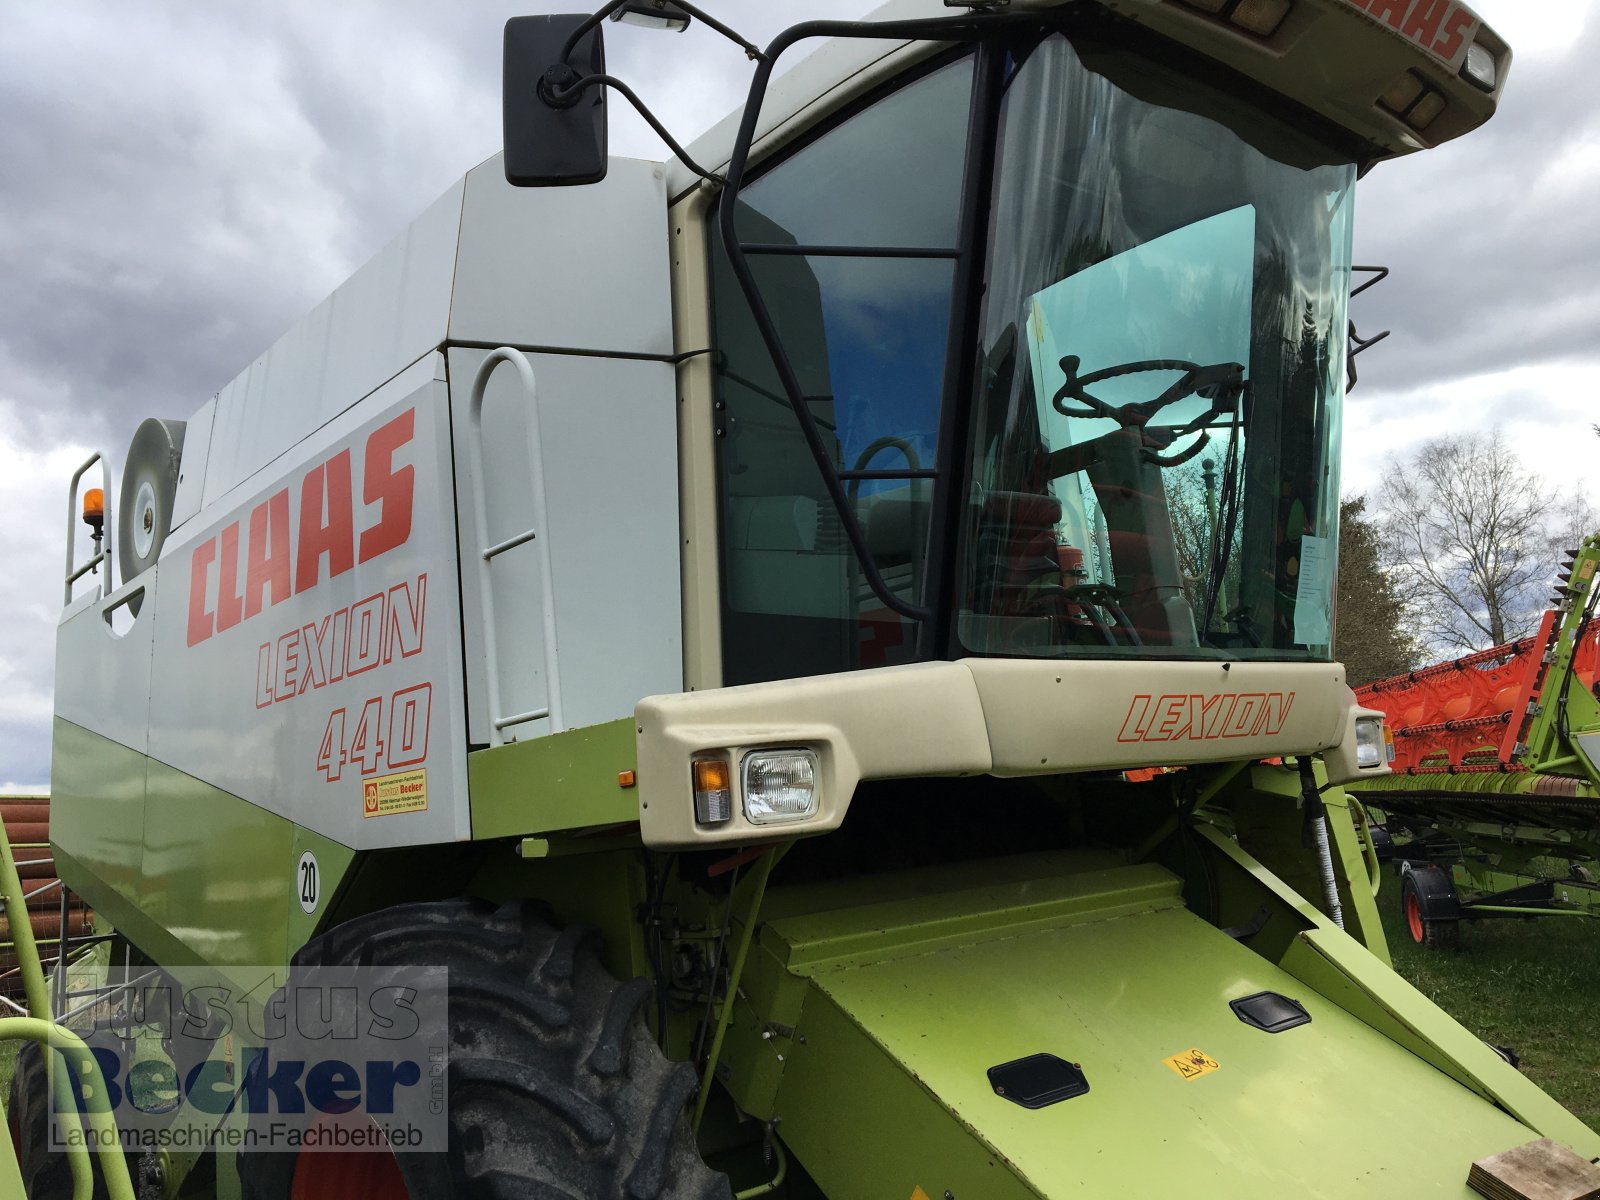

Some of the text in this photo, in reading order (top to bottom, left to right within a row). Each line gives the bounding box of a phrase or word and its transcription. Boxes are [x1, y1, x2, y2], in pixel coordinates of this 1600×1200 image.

[187, 407, 415, 648] CLAAS
[256, 573, 427, 709] LEXION
[317, 682, 432, 783] 440
[1117, 692, 1295, 742] LEXION
[400, 783, 423, 794] Becker
[301, 861, 316, 903] 20
